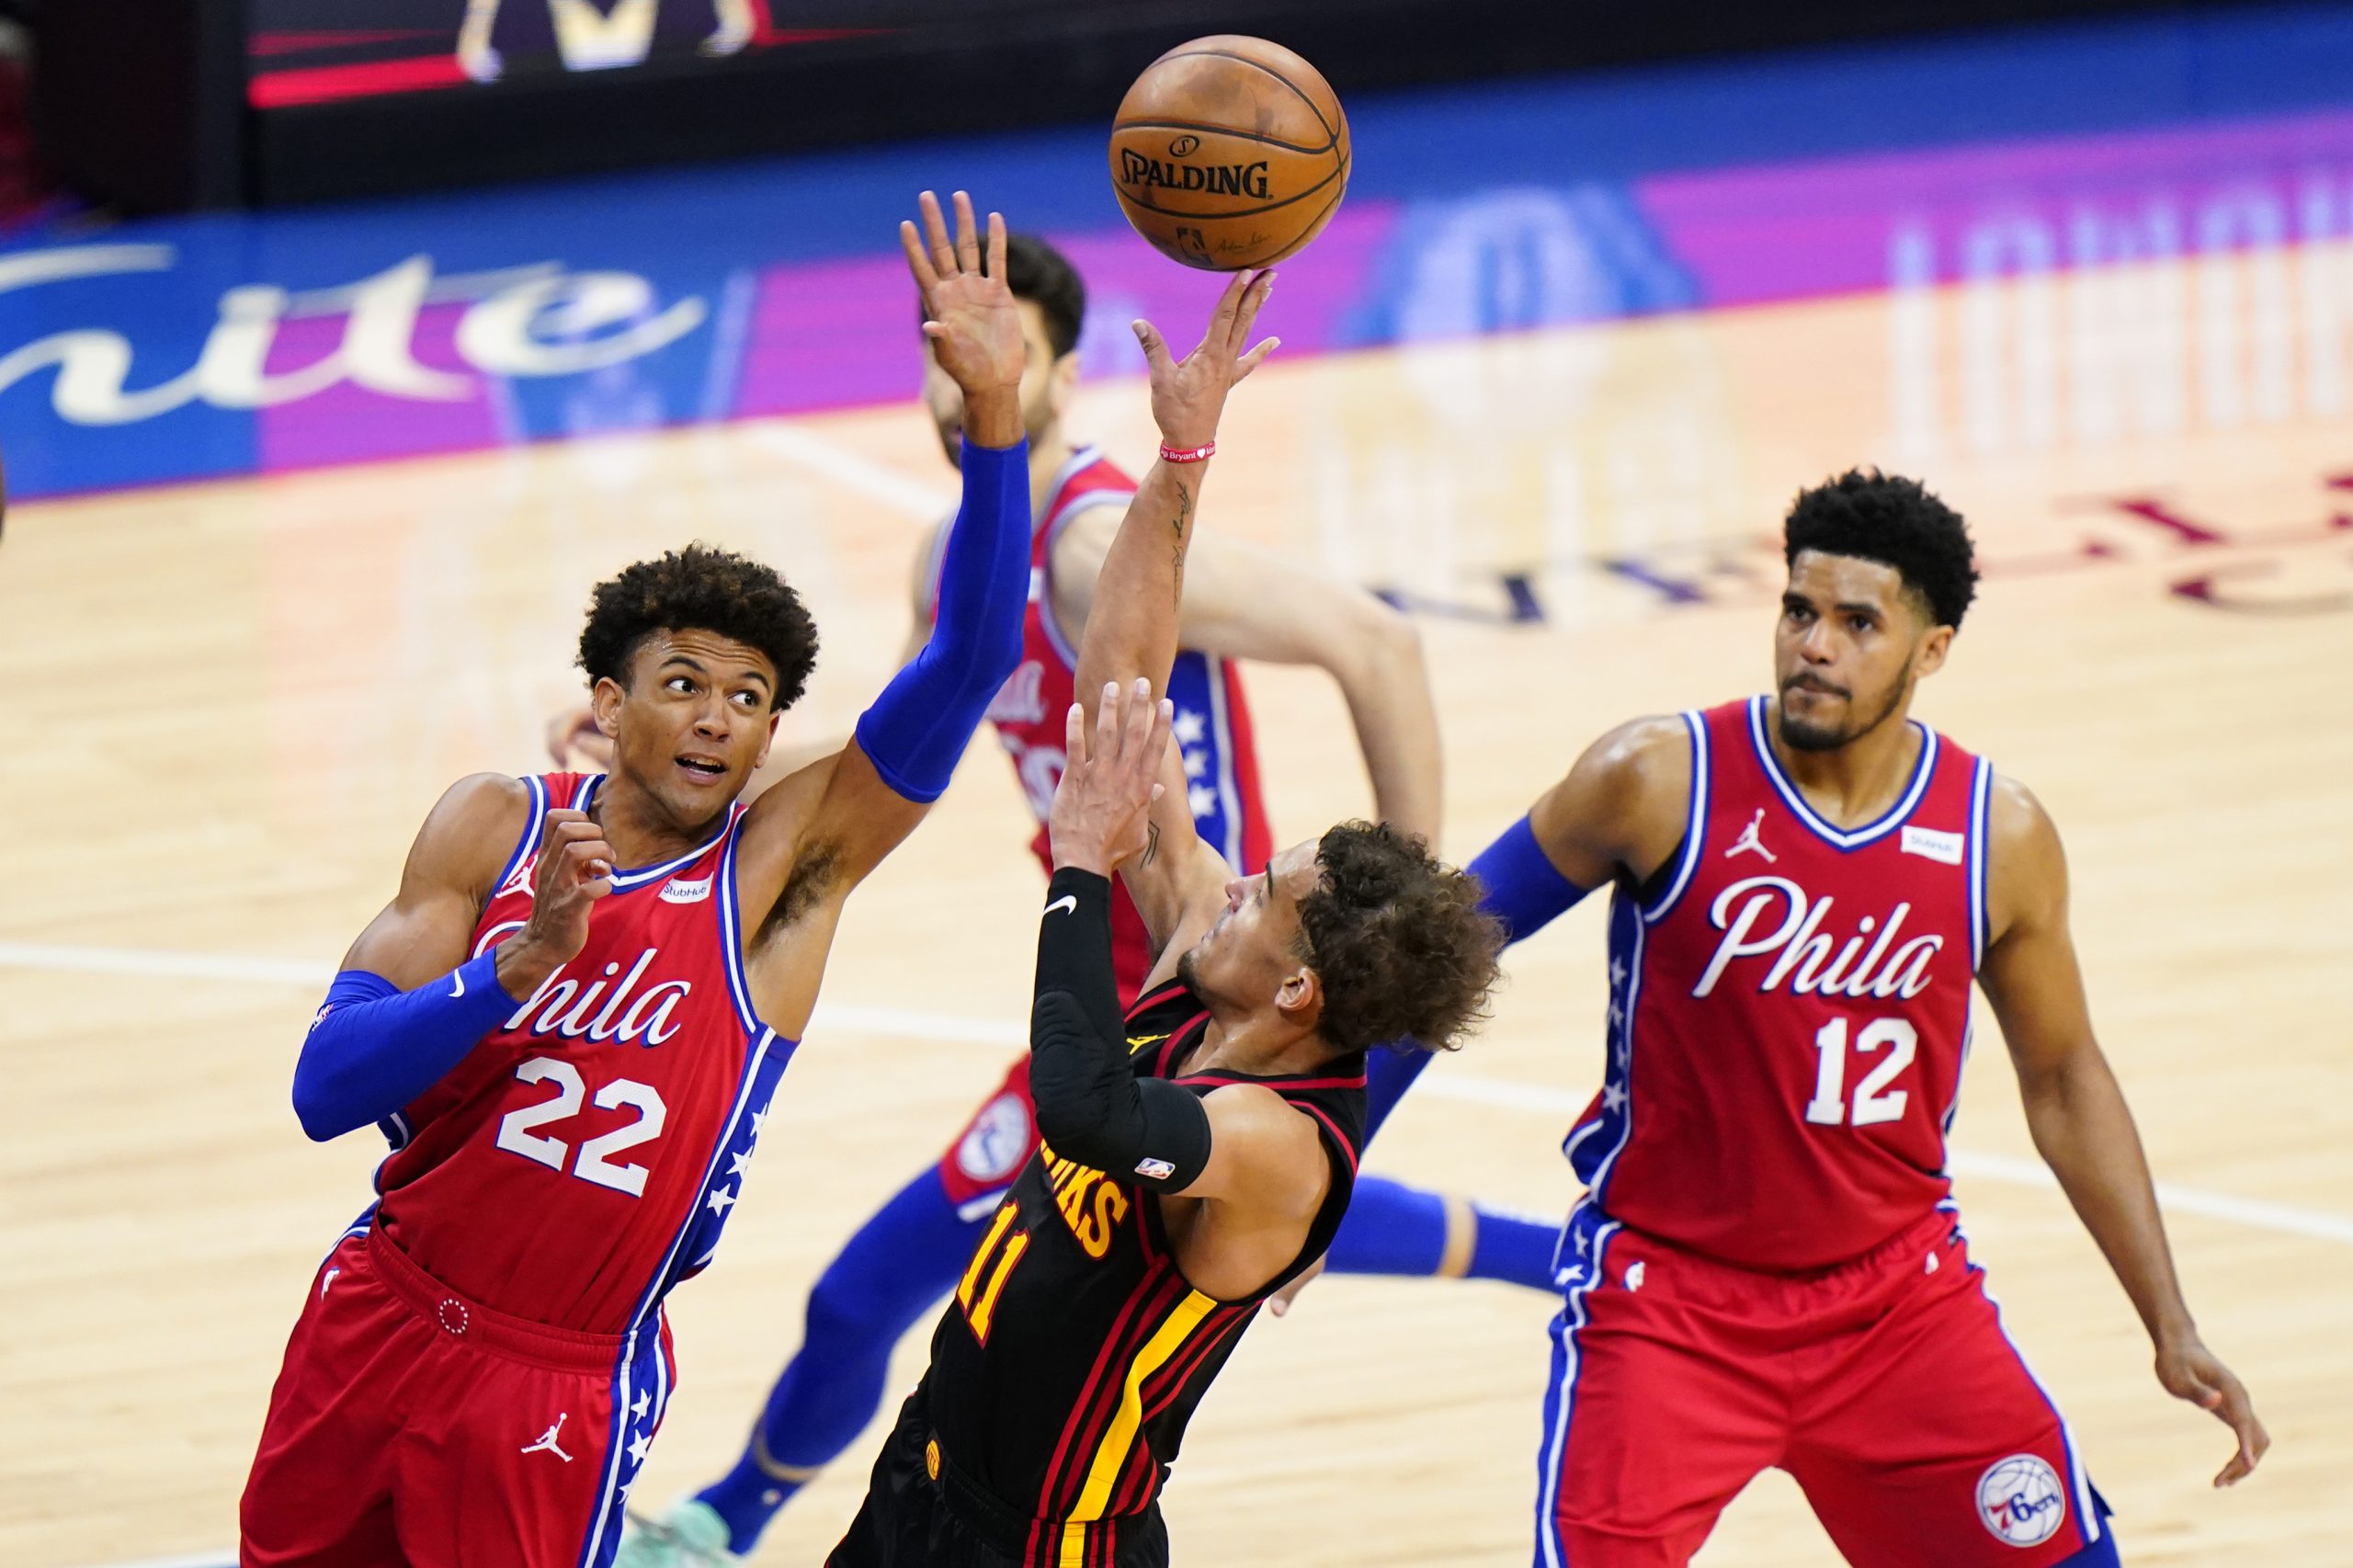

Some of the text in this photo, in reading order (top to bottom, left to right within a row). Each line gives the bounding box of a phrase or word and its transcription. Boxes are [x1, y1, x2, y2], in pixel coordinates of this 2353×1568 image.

[1121, 147, 1268, 200] SPALDING
[1169, 451, 1197, 461] Bryant
[664, 882, 707, 898] StubHub
[1692, 875, 1945, 1000] Phila
[472, 920, 691, 1048] hila
[1806, 1017, 1919, 1127] 12
[495, 1056, 667, 1199] 22
[956, 1198, 1029, 1349] 11
[1988, 1492, 2060, 1531] 76ers
